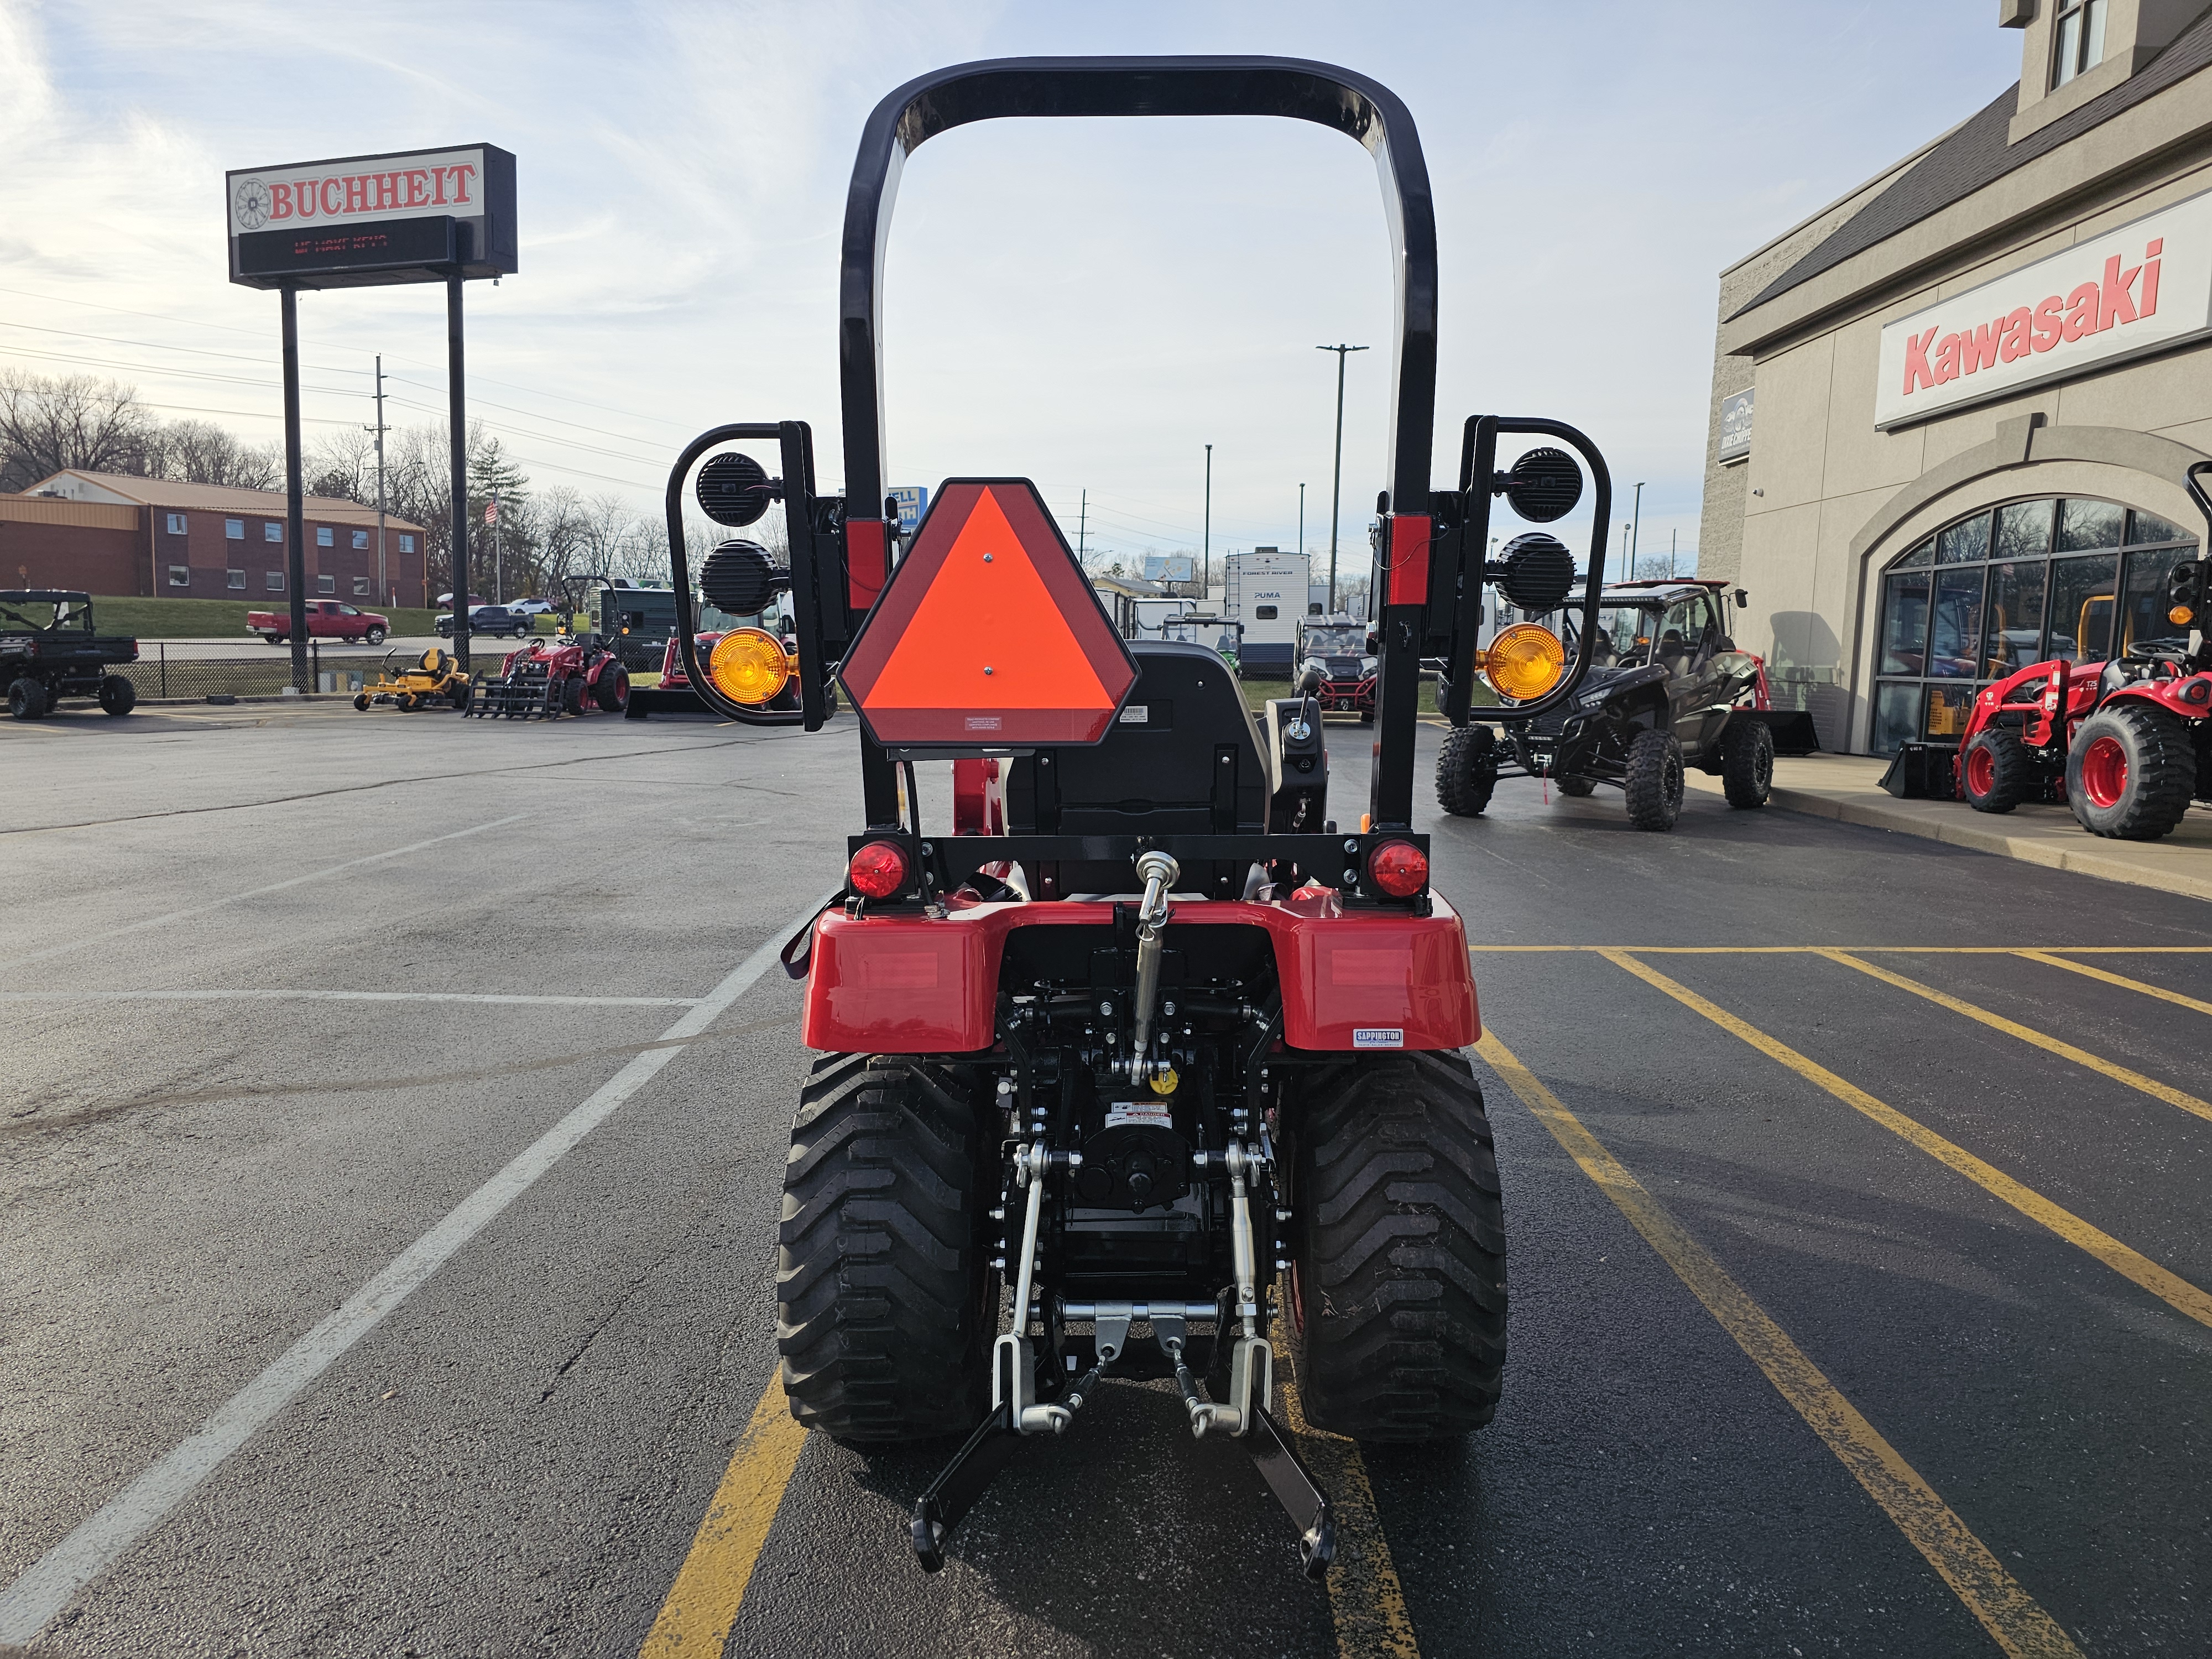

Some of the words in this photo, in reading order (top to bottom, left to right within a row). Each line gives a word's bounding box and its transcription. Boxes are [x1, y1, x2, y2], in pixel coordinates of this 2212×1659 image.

[269, 164, 477, 220] BUCHHEIT
[1903, 237, 2163, 395] Kawasaki
[1733, 427, 1752, 445] CHOPPE
[1357, 1031, 1400, 1040] SAPPINGTON
